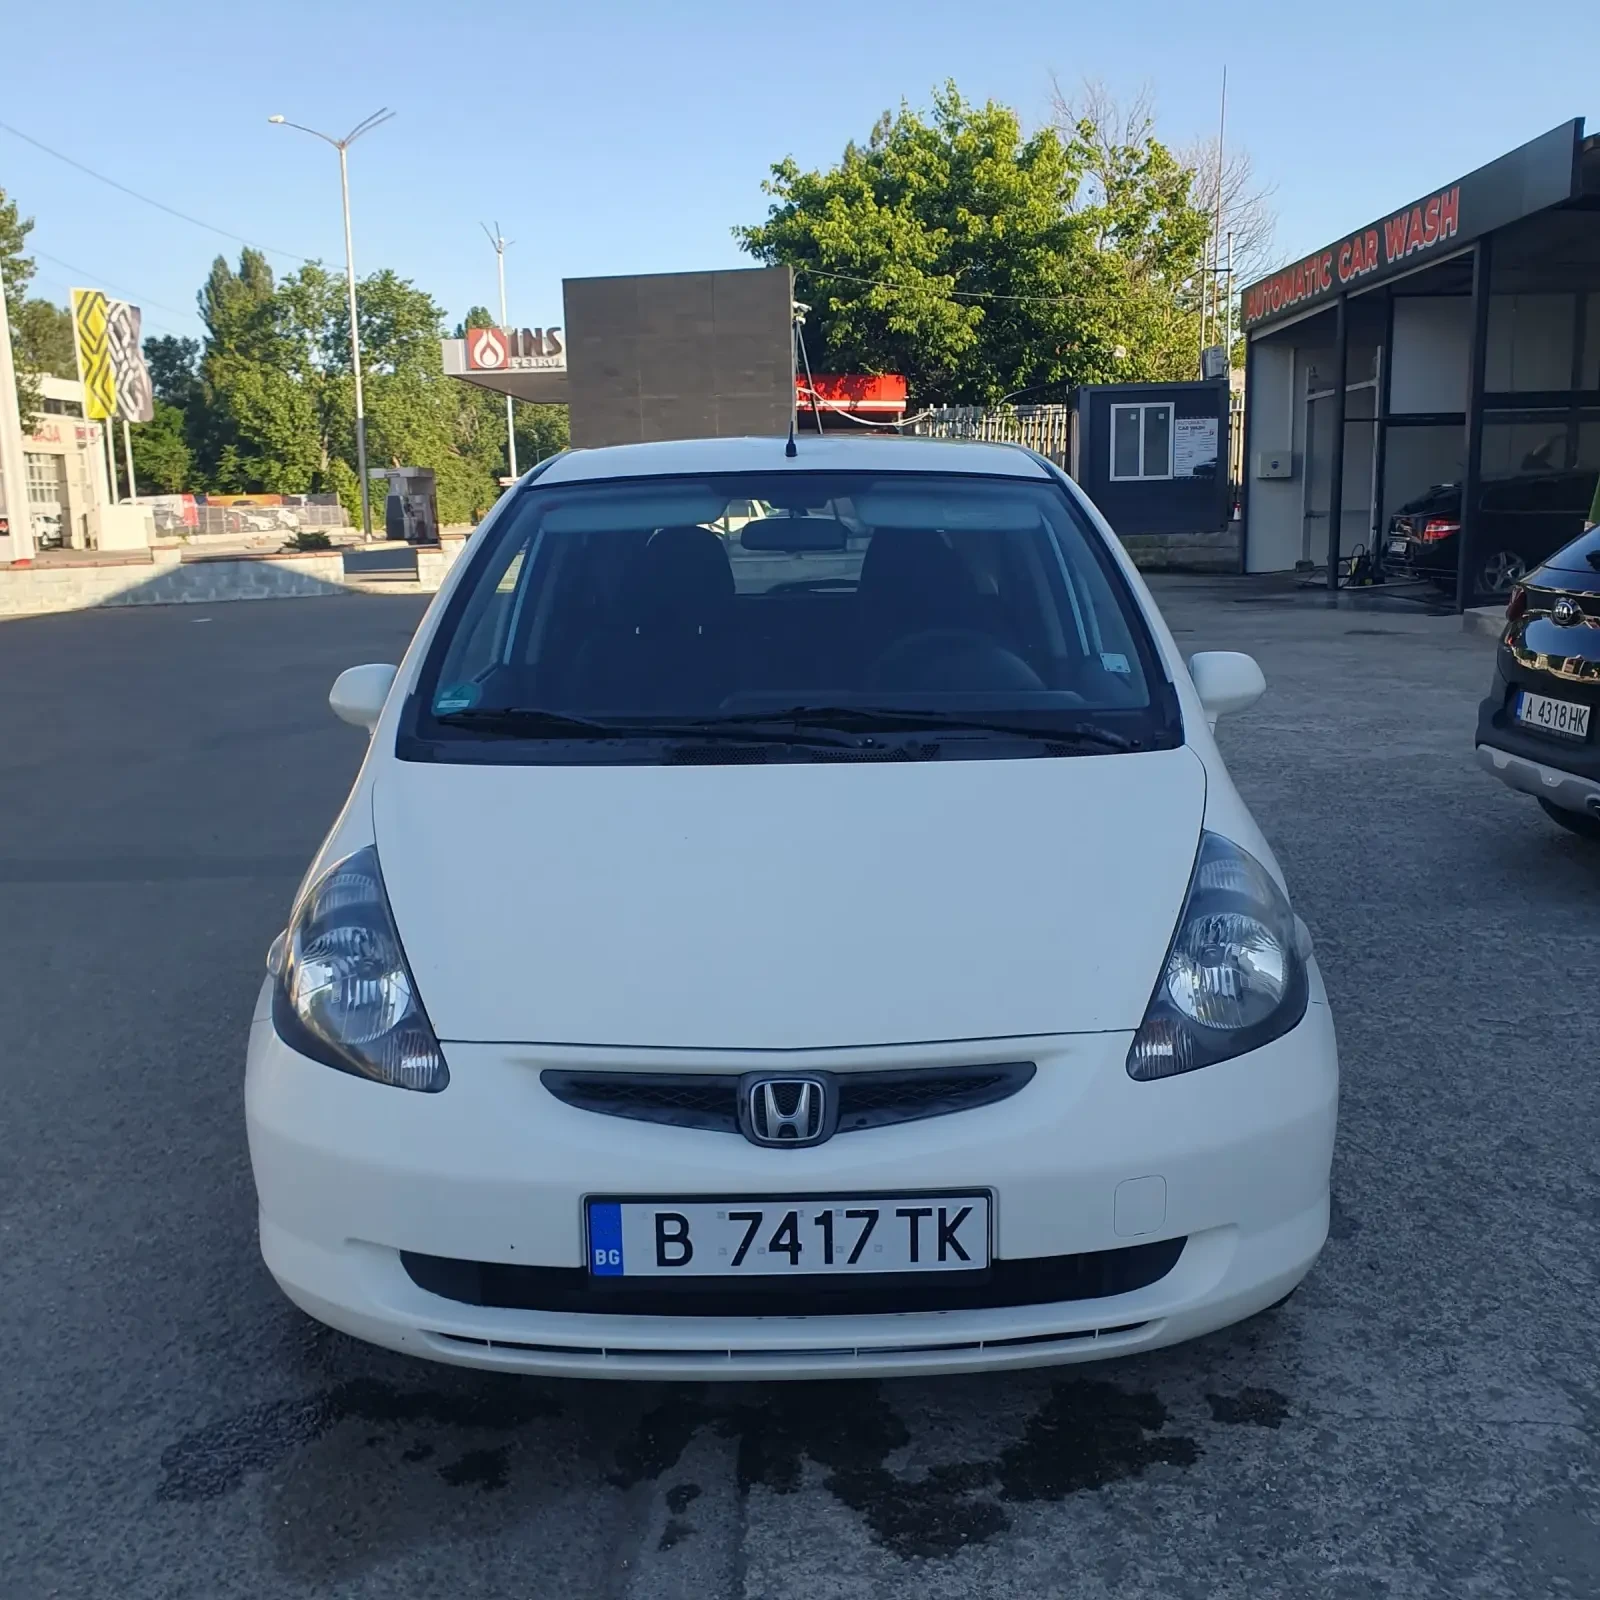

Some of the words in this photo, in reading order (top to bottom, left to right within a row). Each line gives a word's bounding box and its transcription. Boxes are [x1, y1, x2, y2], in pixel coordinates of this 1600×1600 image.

[1246, 252, 1332, 324] AUTOMATIC
[1338, 229, 1379, 284] CAR
[1384, 186, 1460, 264] WASH
[510, 327, 562, 356] INS
[1525, 697, 1533, 720] A
[1538, 700, 1567, 728] 4318
[1568, 706, 1588, 734] HK
[595, 1249, 620, 1265] BG
[655, 1212, 694, 1267] B
[728, 1209, 879, 1267] 7417
[895, 1206, 973, 1263] TK
